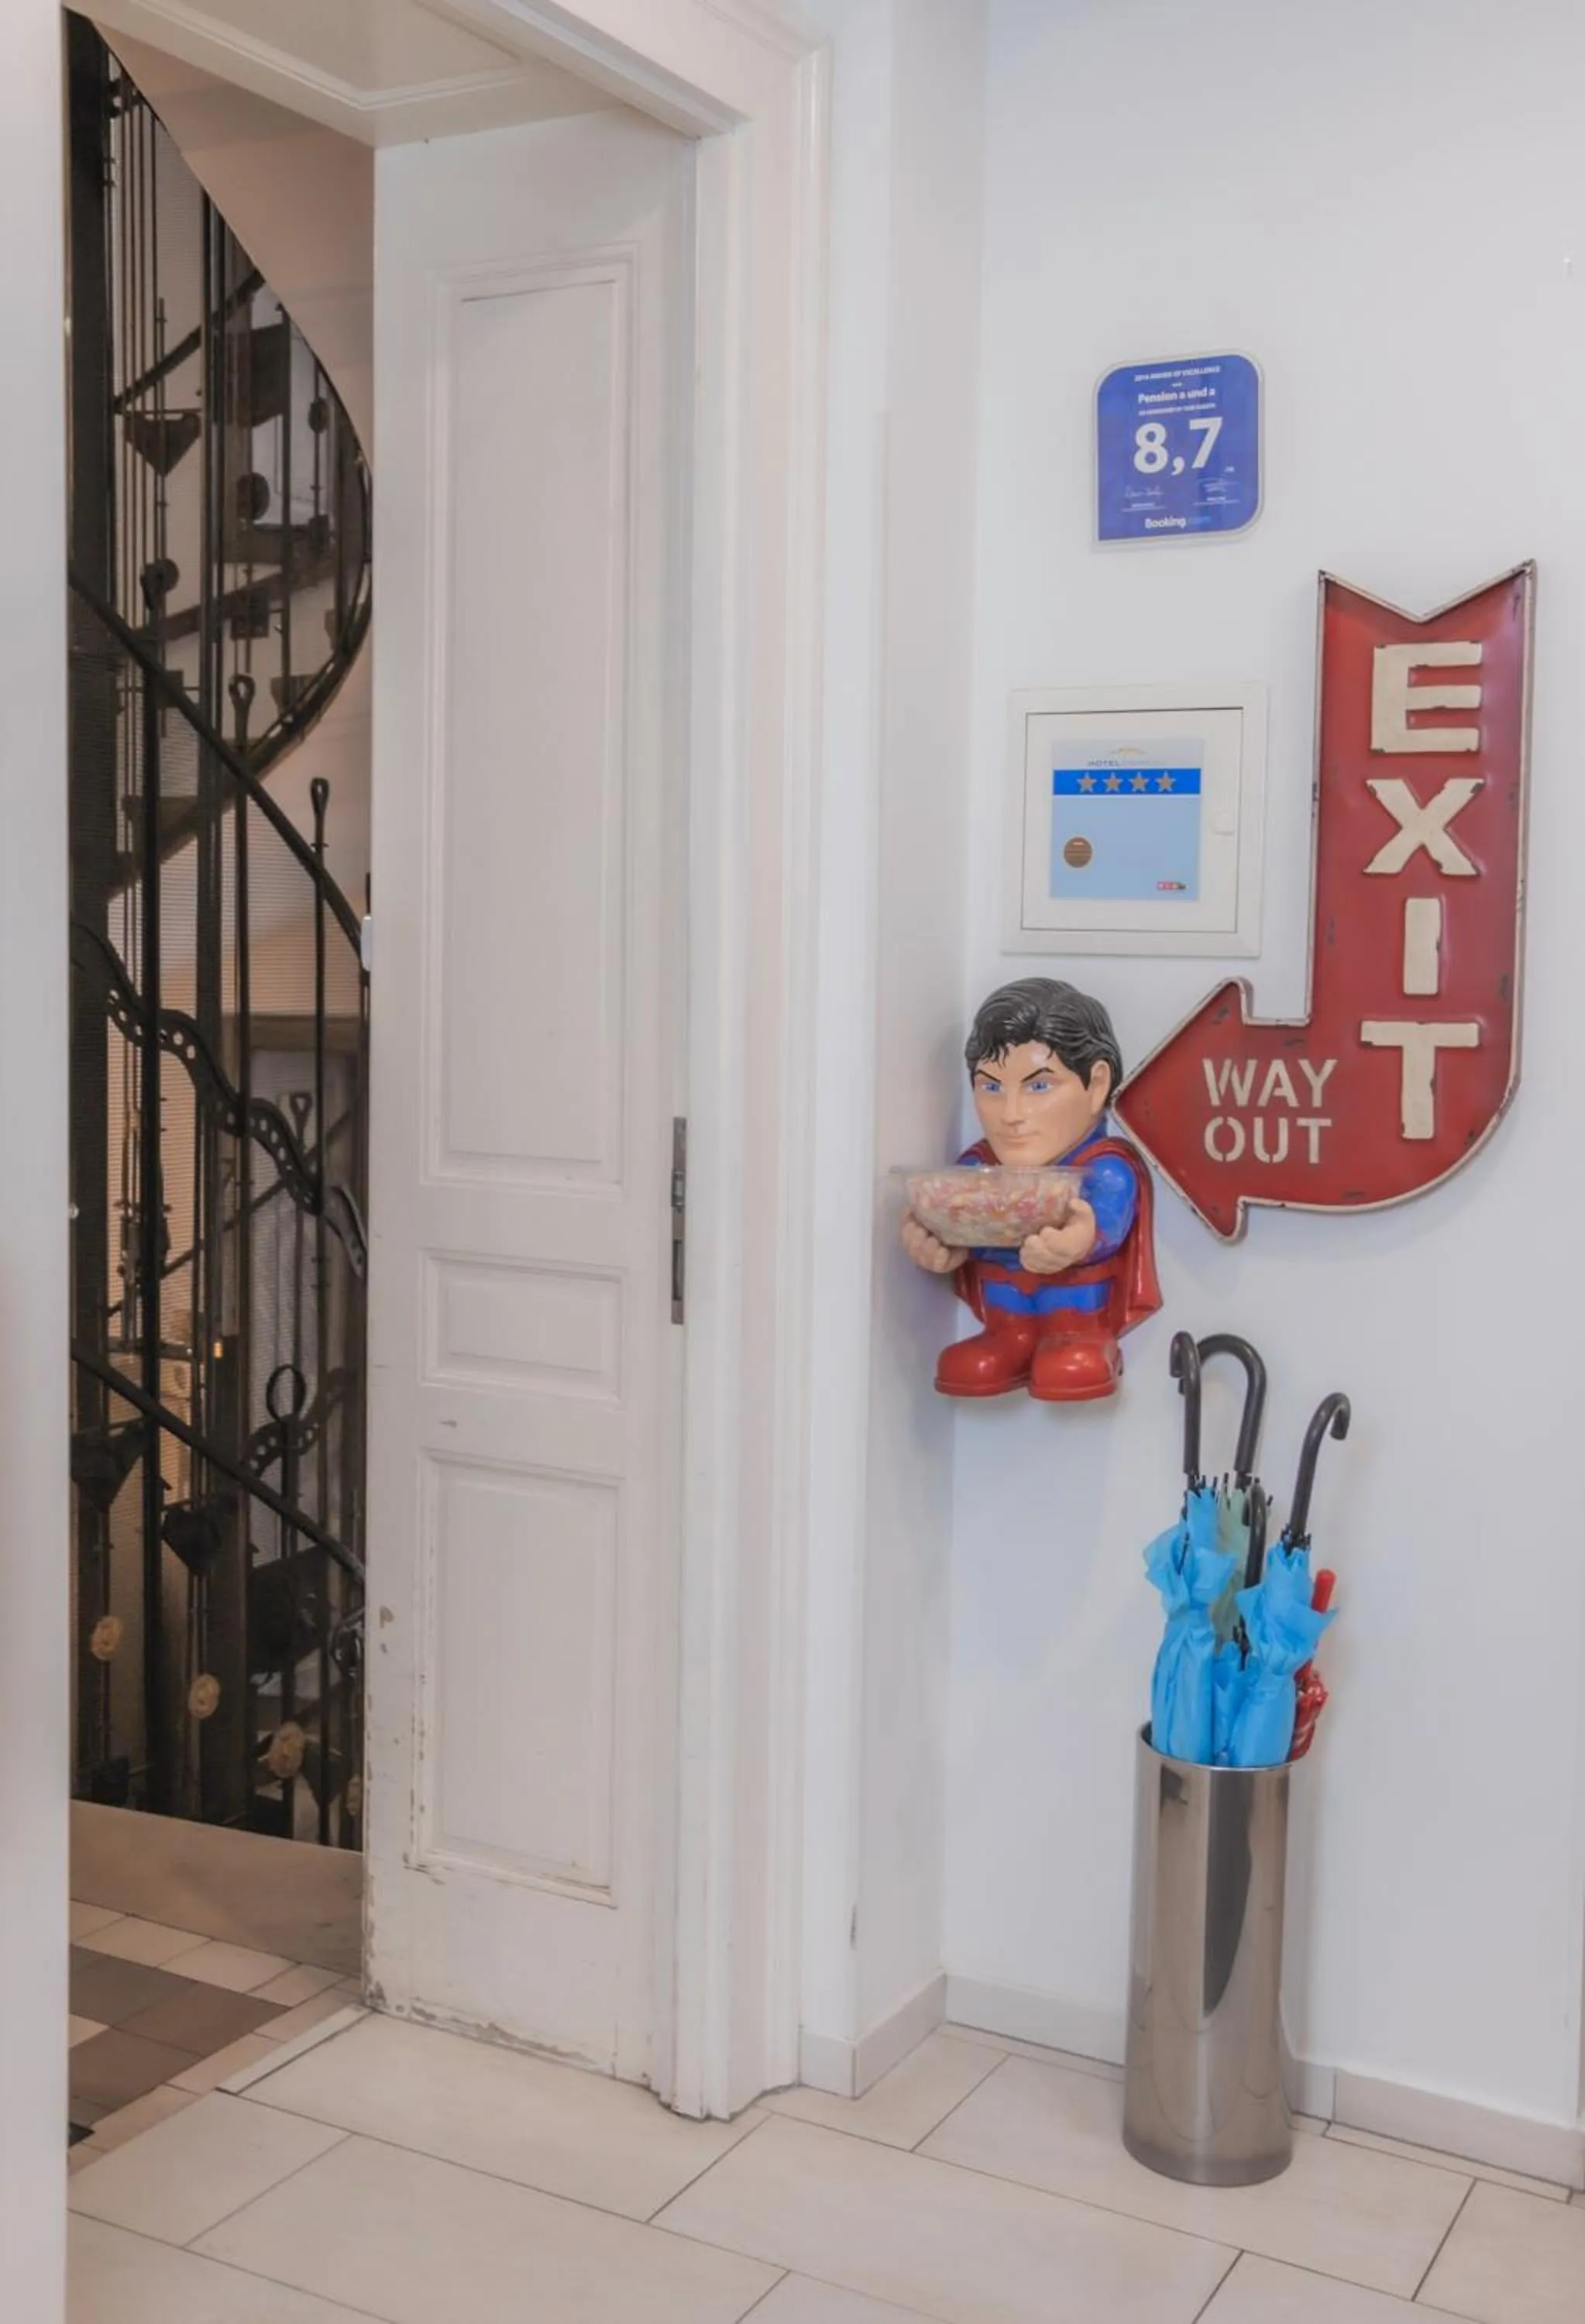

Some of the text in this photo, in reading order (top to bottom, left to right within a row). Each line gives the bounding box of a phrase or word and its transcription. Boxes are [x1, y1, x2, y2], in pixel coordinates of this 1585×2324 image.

[1138, 391, 1178, 404] Pension
[1187, 387, 1207, 398] und
[1134, 417, 1223, 476] 8,7
[1360, 642, 1485, 1140] EXIT
[1202, 1057, 1338, 1108] WAY
[1204, 1116, 1332, 1164] OUT
